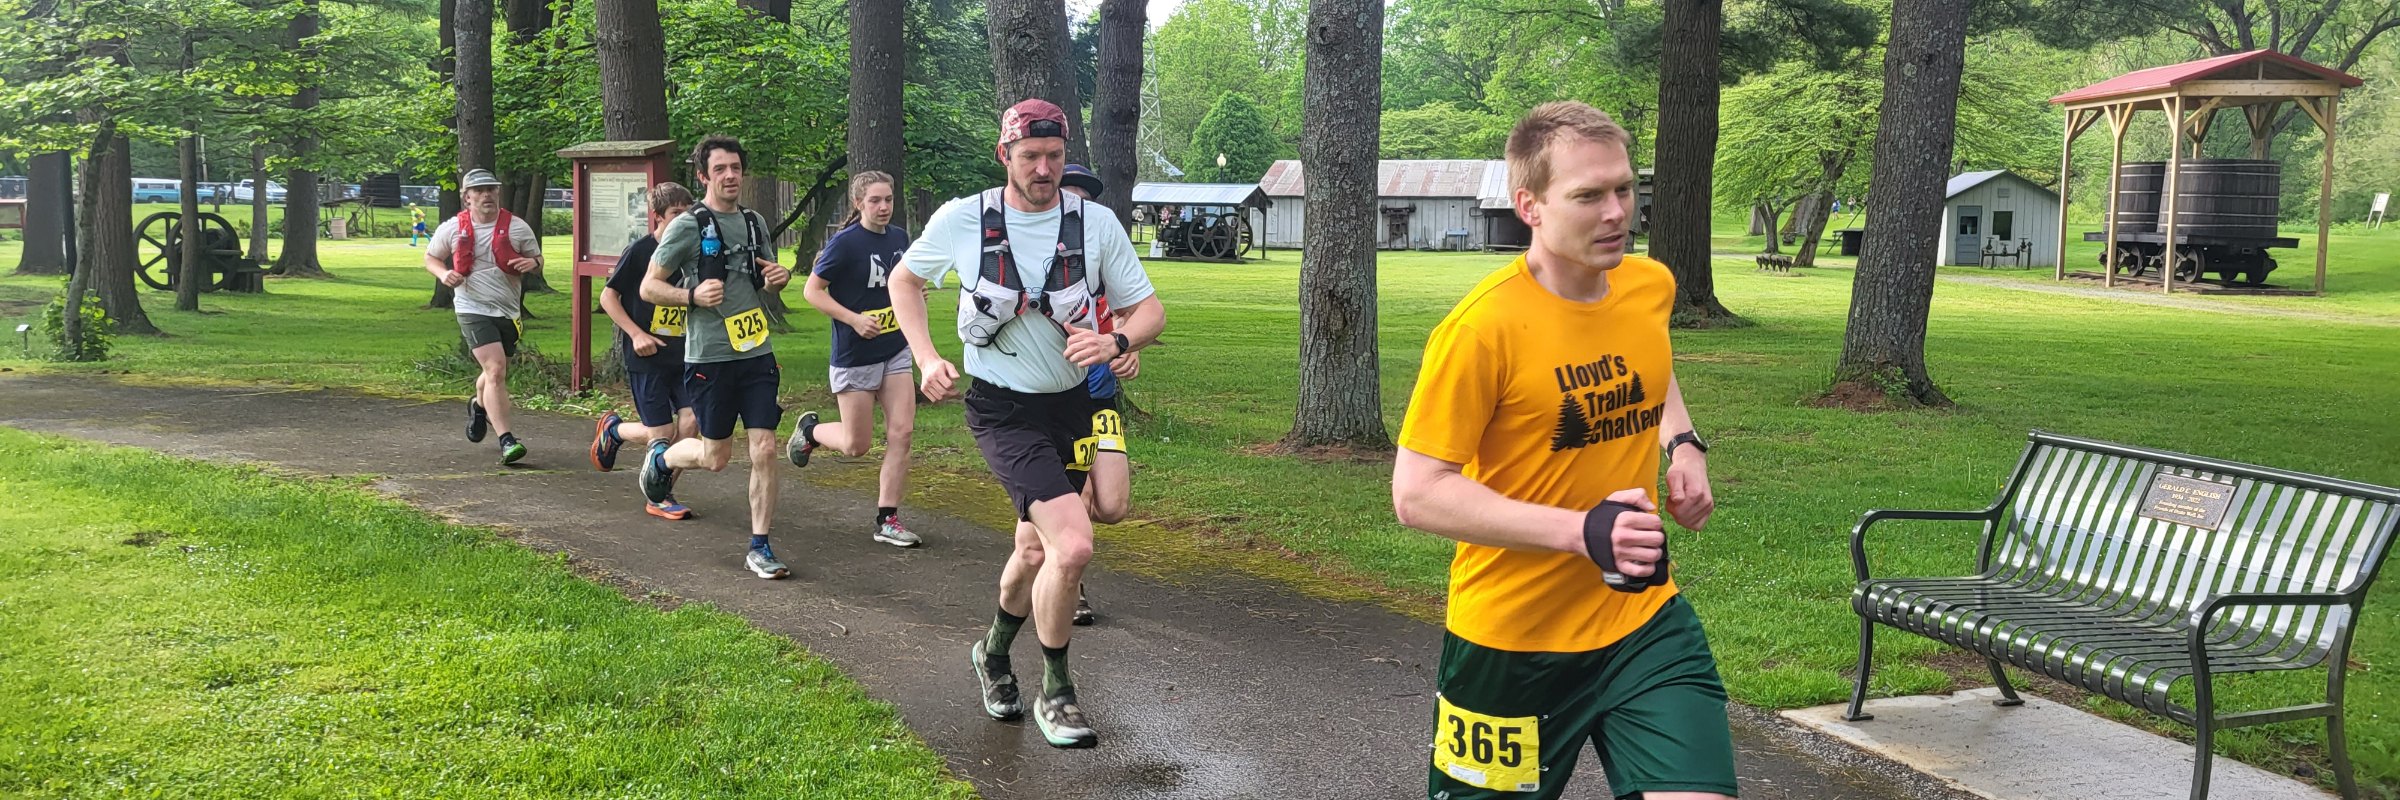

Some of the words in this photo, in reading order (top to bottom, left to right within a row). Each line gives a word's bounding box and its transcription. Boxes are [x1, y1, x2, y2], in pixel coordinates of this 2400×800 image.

[733, 312, 763, 339] 325
[869, 310, 896, 331] 22
[1554, 353, 1628, 393] Lloyd's
[1584, 382, 1628, 418] Trail
[1097, 413, 1123, 436] 31
[1079, 442, 1099, 467] 30
[1448, 714, 1522, 768] 365
